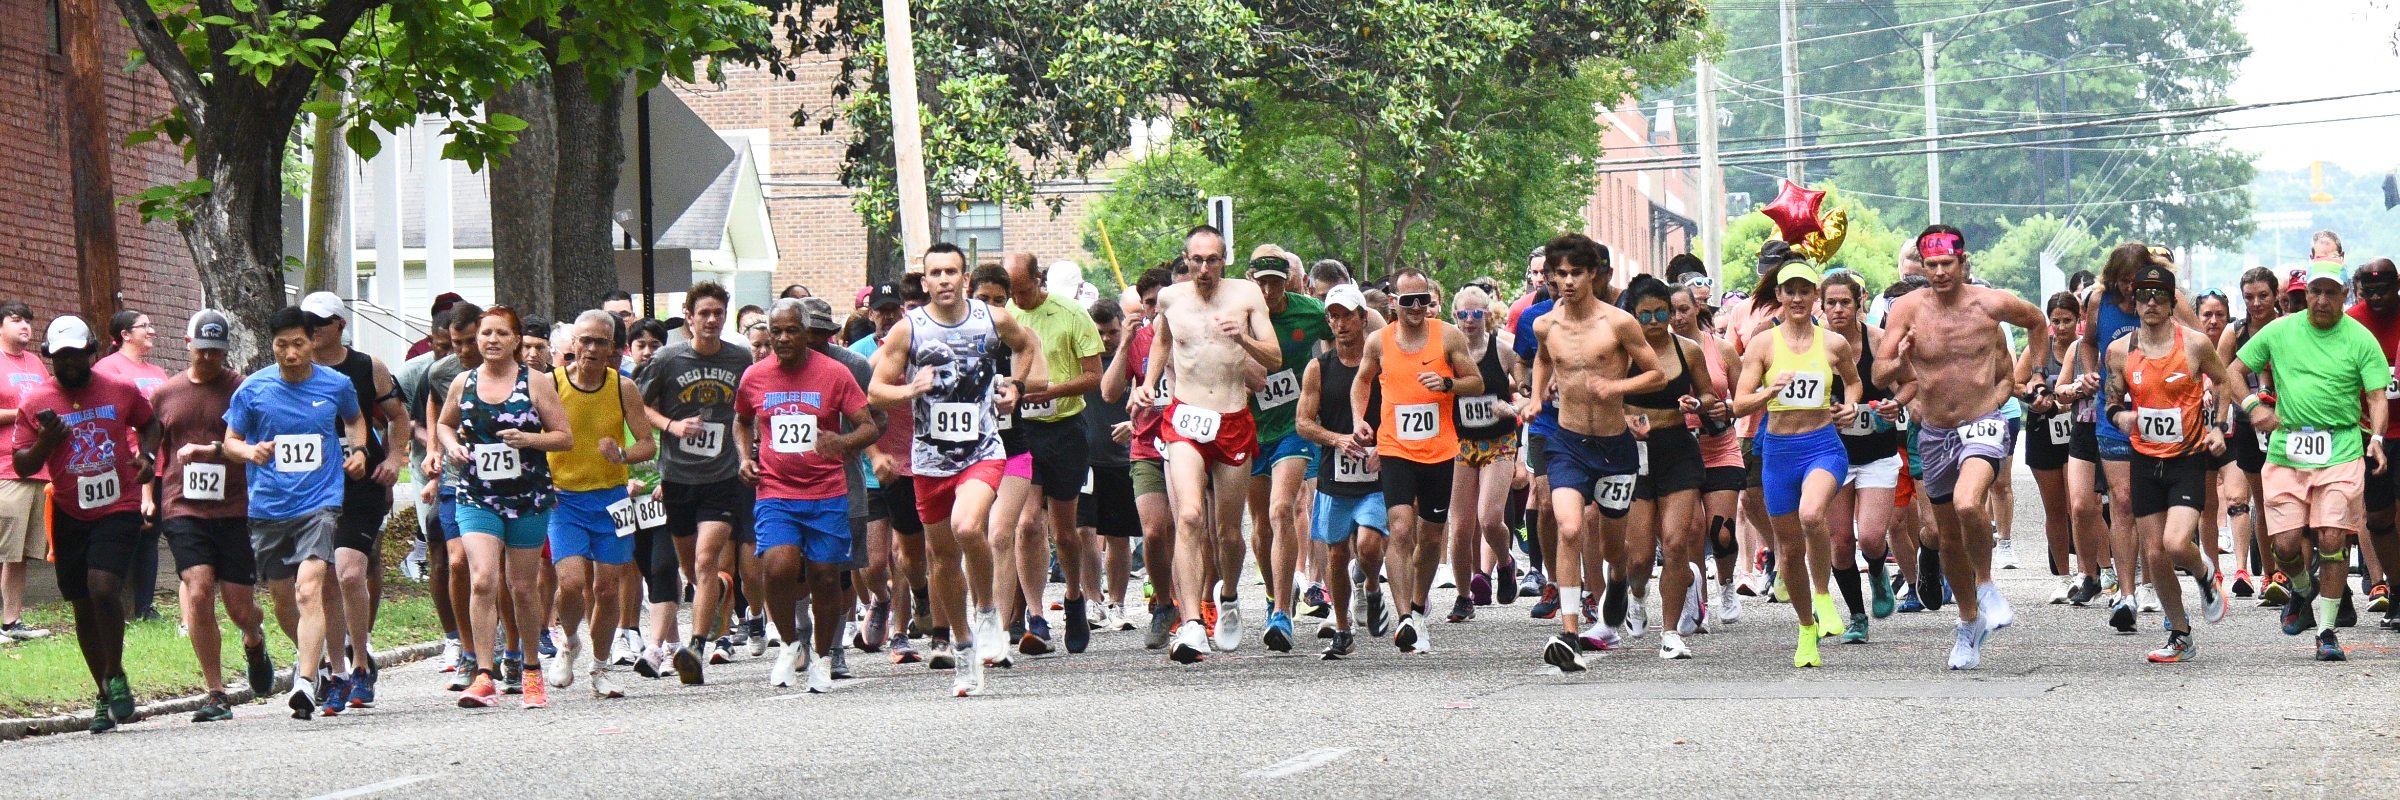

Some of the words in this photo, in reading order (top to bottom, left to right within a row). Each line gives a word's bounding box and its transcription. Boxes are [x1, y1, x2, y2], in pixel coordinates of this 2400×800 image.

[676, 370, 701, 388] RED
[704, 367, 737, 386] LEVEL
[1264, 377, 1294, 401] 342
[1785, 379, 1818, 399] 337
[763, 391, 800, 411] JUBILEE
[801, 391, 821, 410] RUN
[1465, 401, 1493, 420] 895
[937, 411, 972, 433] 919
[1180, 413, 1213, 436] 839
[1402, 411, 1434, 432] 720
[1966, 421, 1997, 439] 268
[2055, 419, 2071, 438] 91
[2144, 416, 2176, 436] 762
[778, 423, 812, 444] 232
[281, 442, 315, 464] 312
[2294, 435, 2325, 456] 290
[481, 450, 514, 472] 275
[85, 478, 114, 502] 910
[189, 471, 219, 492] 852
[1601, 482, 1631, 501] 753
[612, 505, 635, 529] 872
[640, 501, 665, 521] 880
